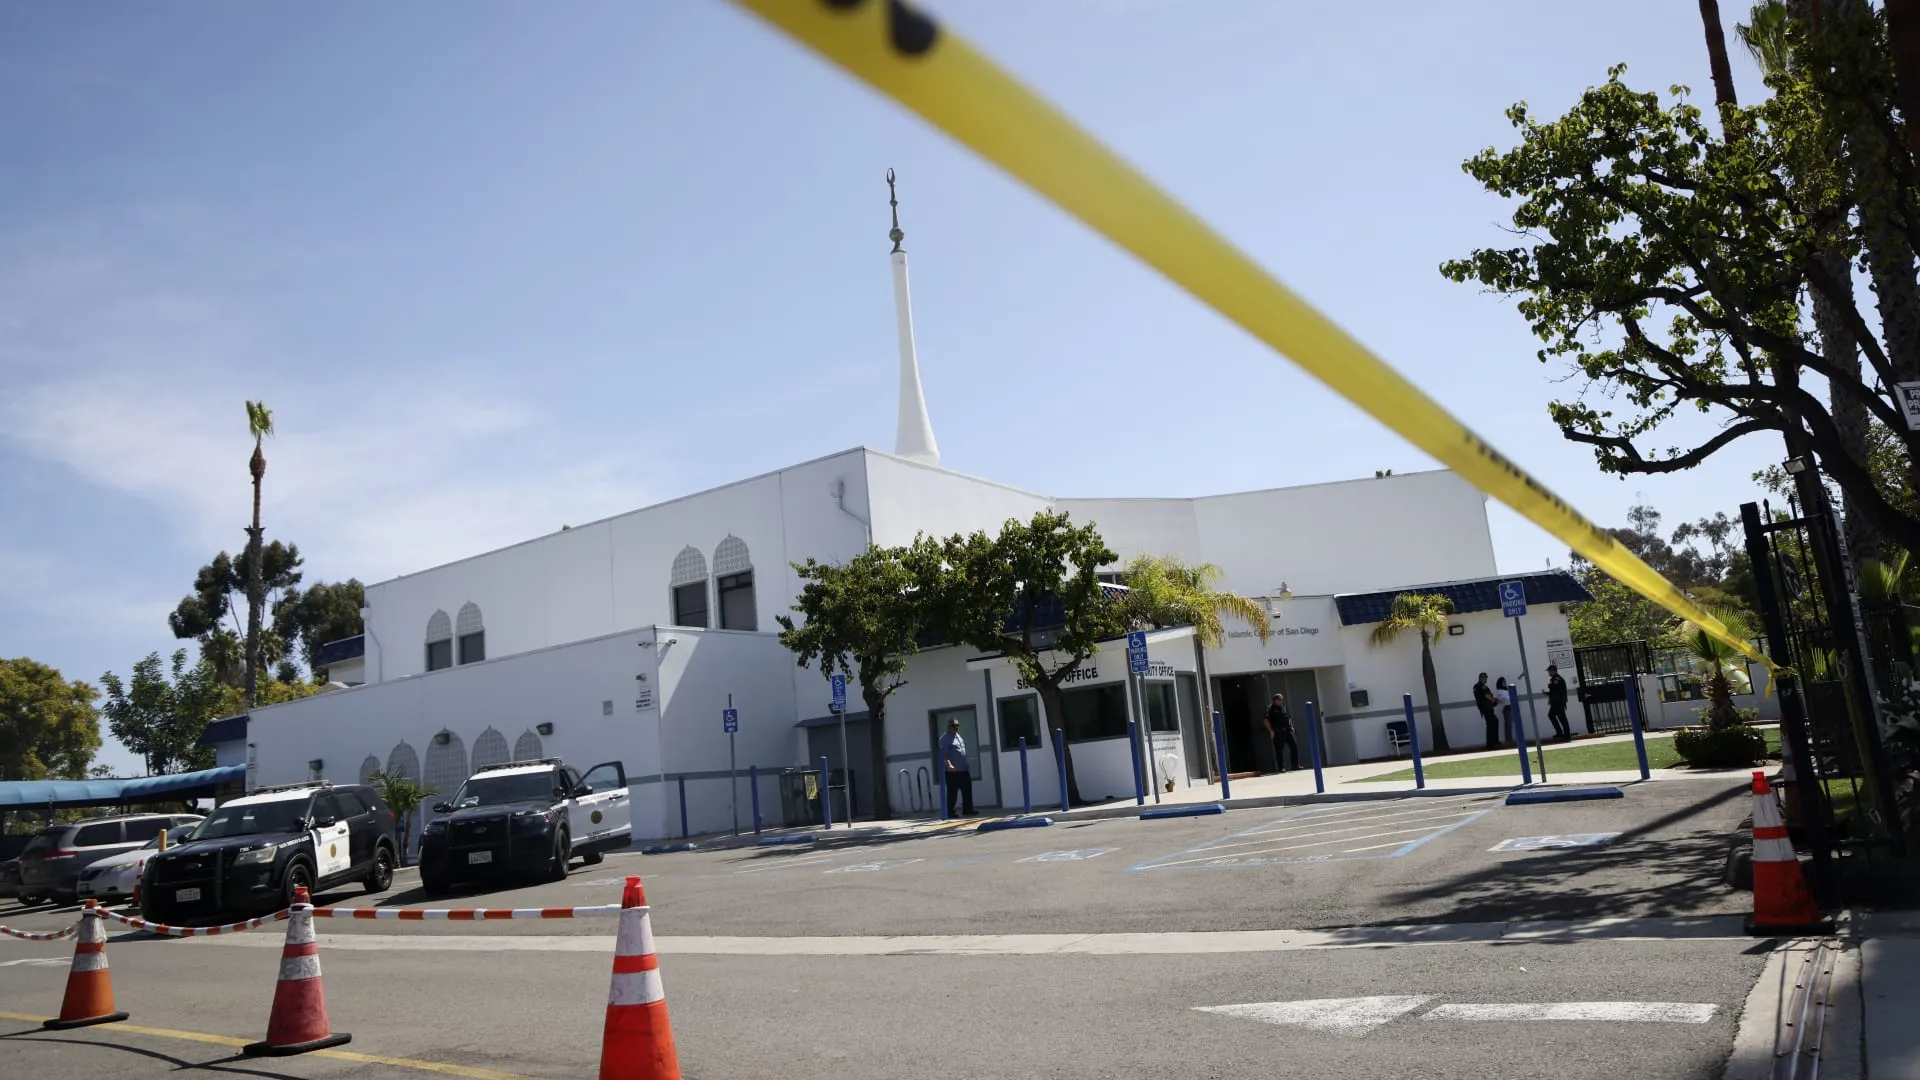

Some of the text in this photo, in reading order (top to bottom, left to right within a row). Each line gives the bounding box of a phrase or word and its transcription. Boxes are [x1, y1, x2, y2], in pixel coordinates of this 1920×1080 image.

[1503, 599, 1524, 608] PARKING
[1508, 606, 1522, 615] ONLY
[1228, 630, 1253, 638] Islamic
[1277, 628, 1284, 636] of
[1285, 628, 1299, 636] San
[1300, 626, 1319, 636] Diego
[1267, 658, 1289, 666] 7050
[1065, 667, 1099, 684] OFFICE
